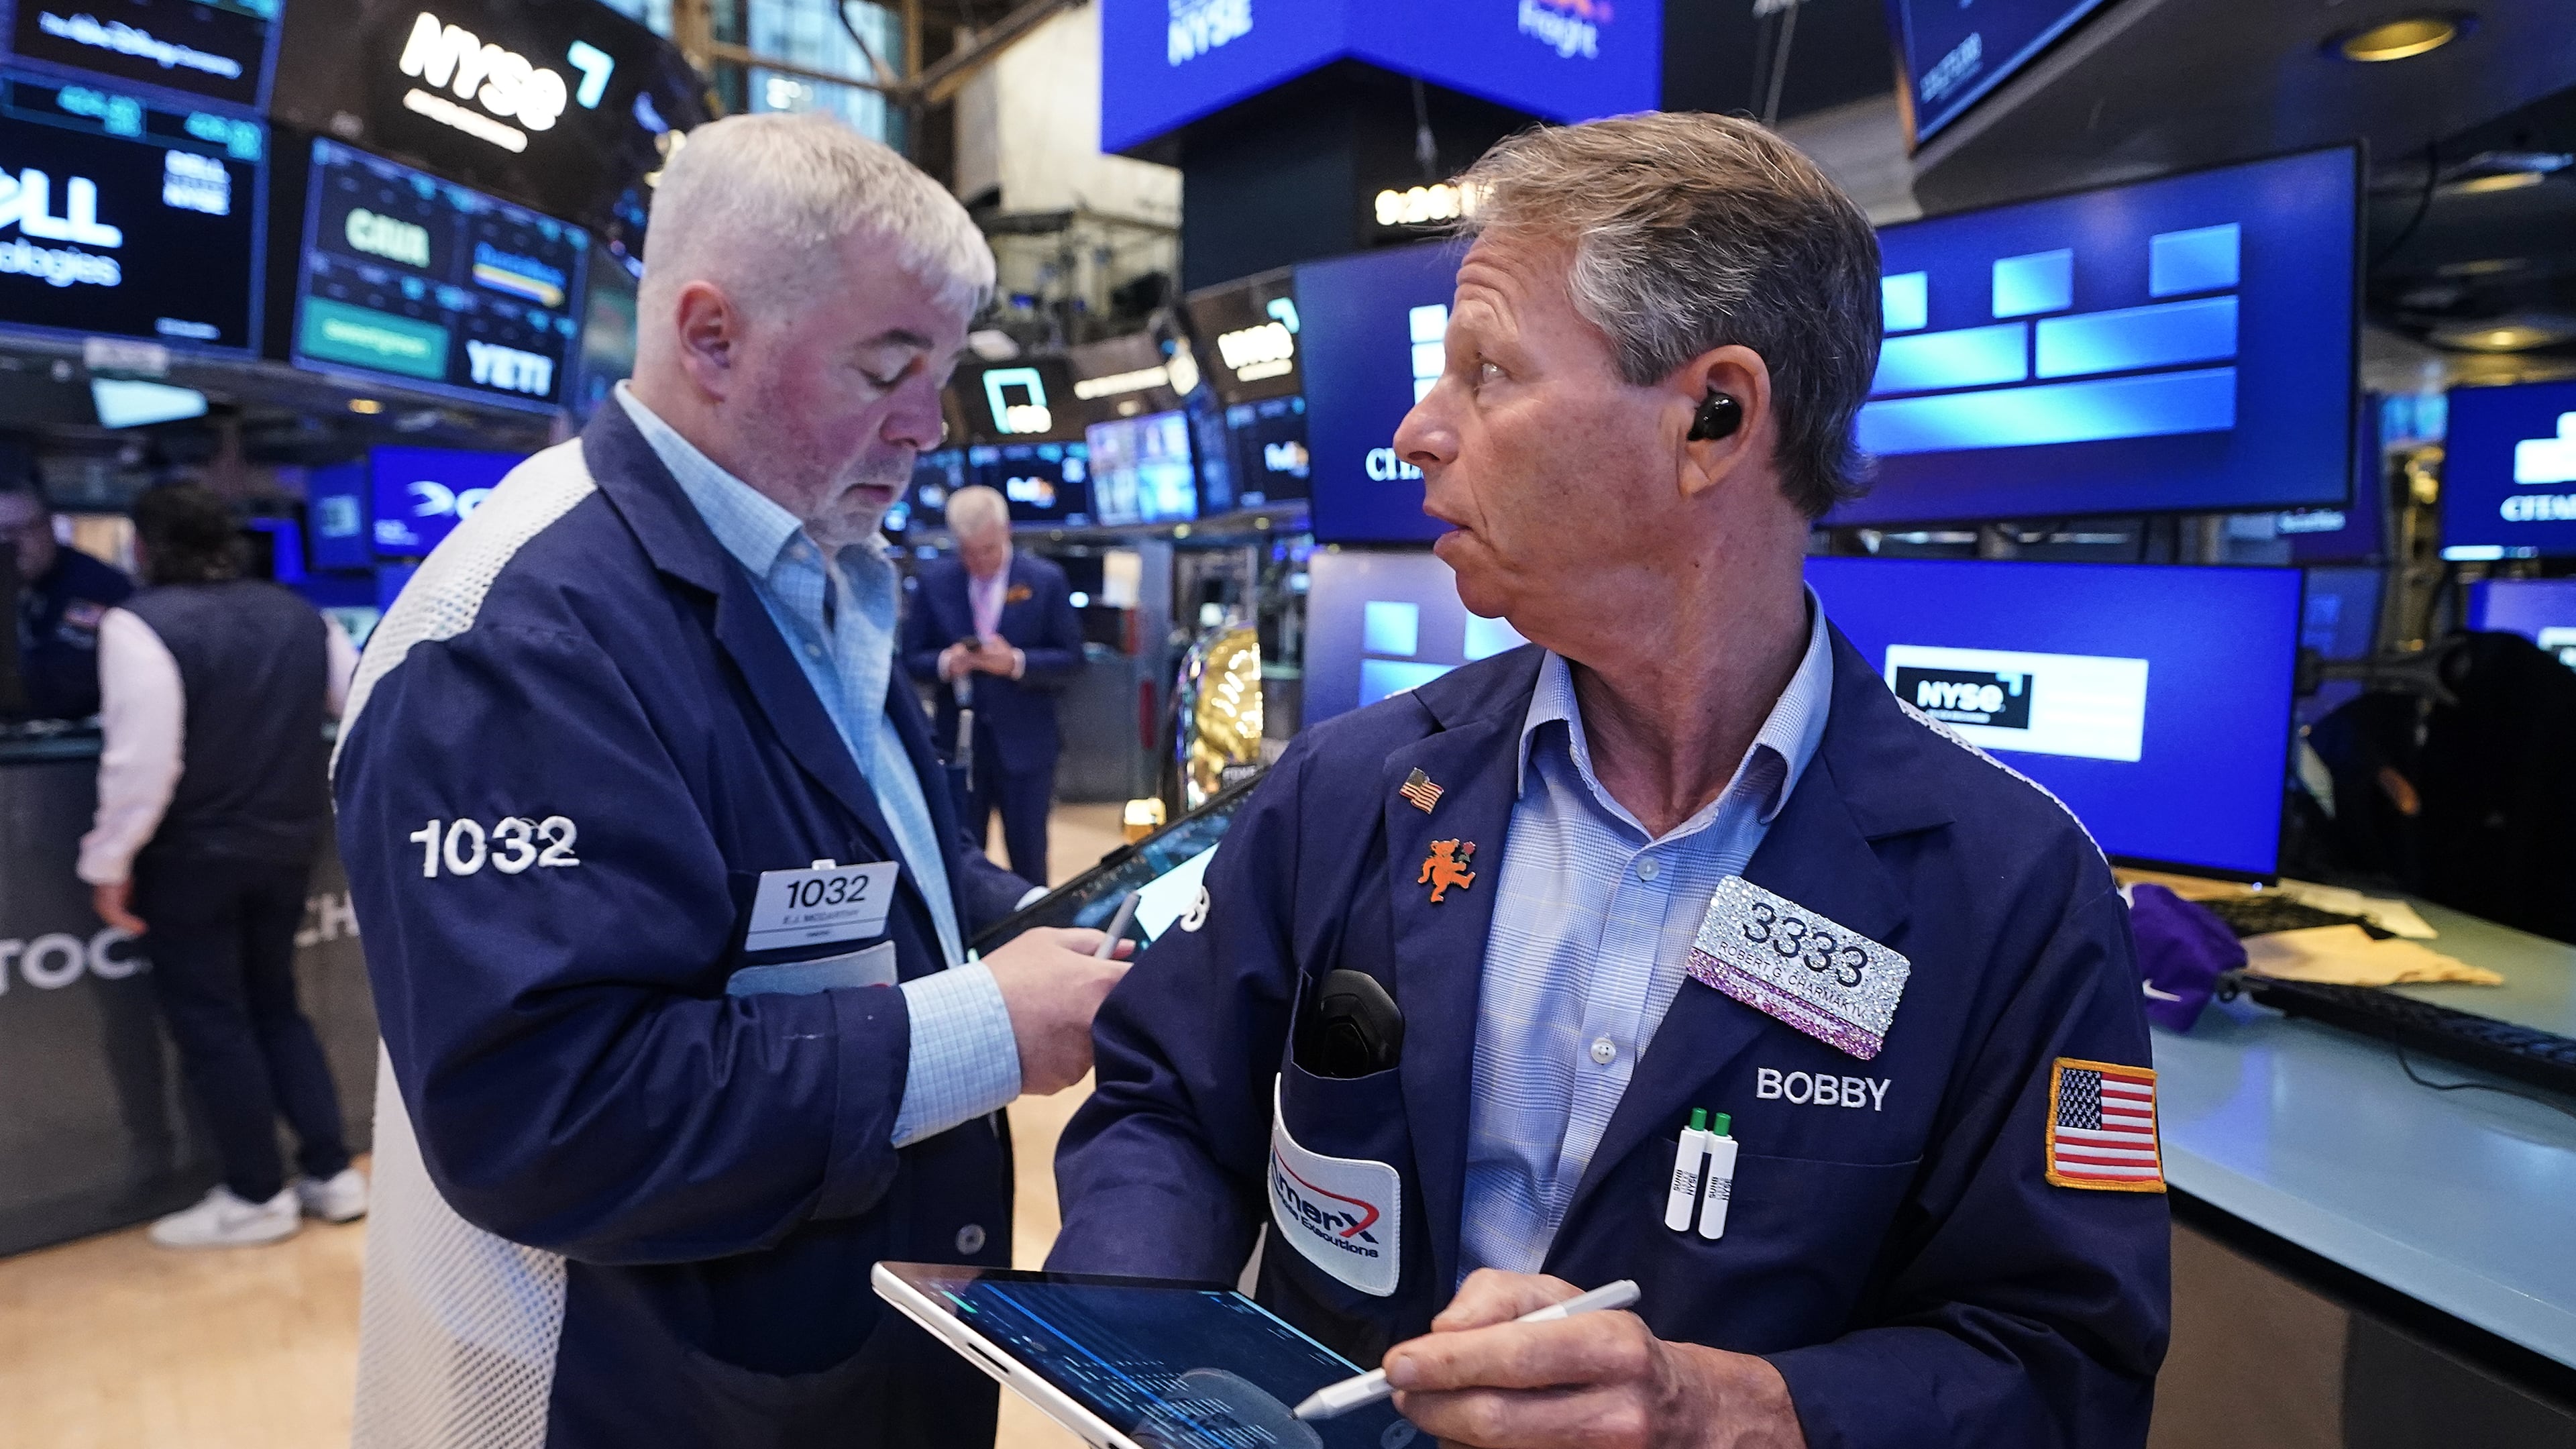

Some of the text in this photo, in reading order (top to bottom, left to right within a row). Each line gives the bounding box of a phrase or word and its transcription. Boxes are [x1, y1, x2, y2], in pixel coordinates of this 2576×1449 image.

[409, 814, 580, 878] 1032
[786, 874, 869, 909] 1032
[1719, 941, 1771, 972] ROBERT
[1788, 975, 1851, 1012] CHARMAK
[1743, 902, 1868, 988] 3333
[1755, 1067, 1892, 1112] BOBBY
[1272, 1149, 1380, 1245] merX
[1301, 1215, 1379, 1259] Executions
